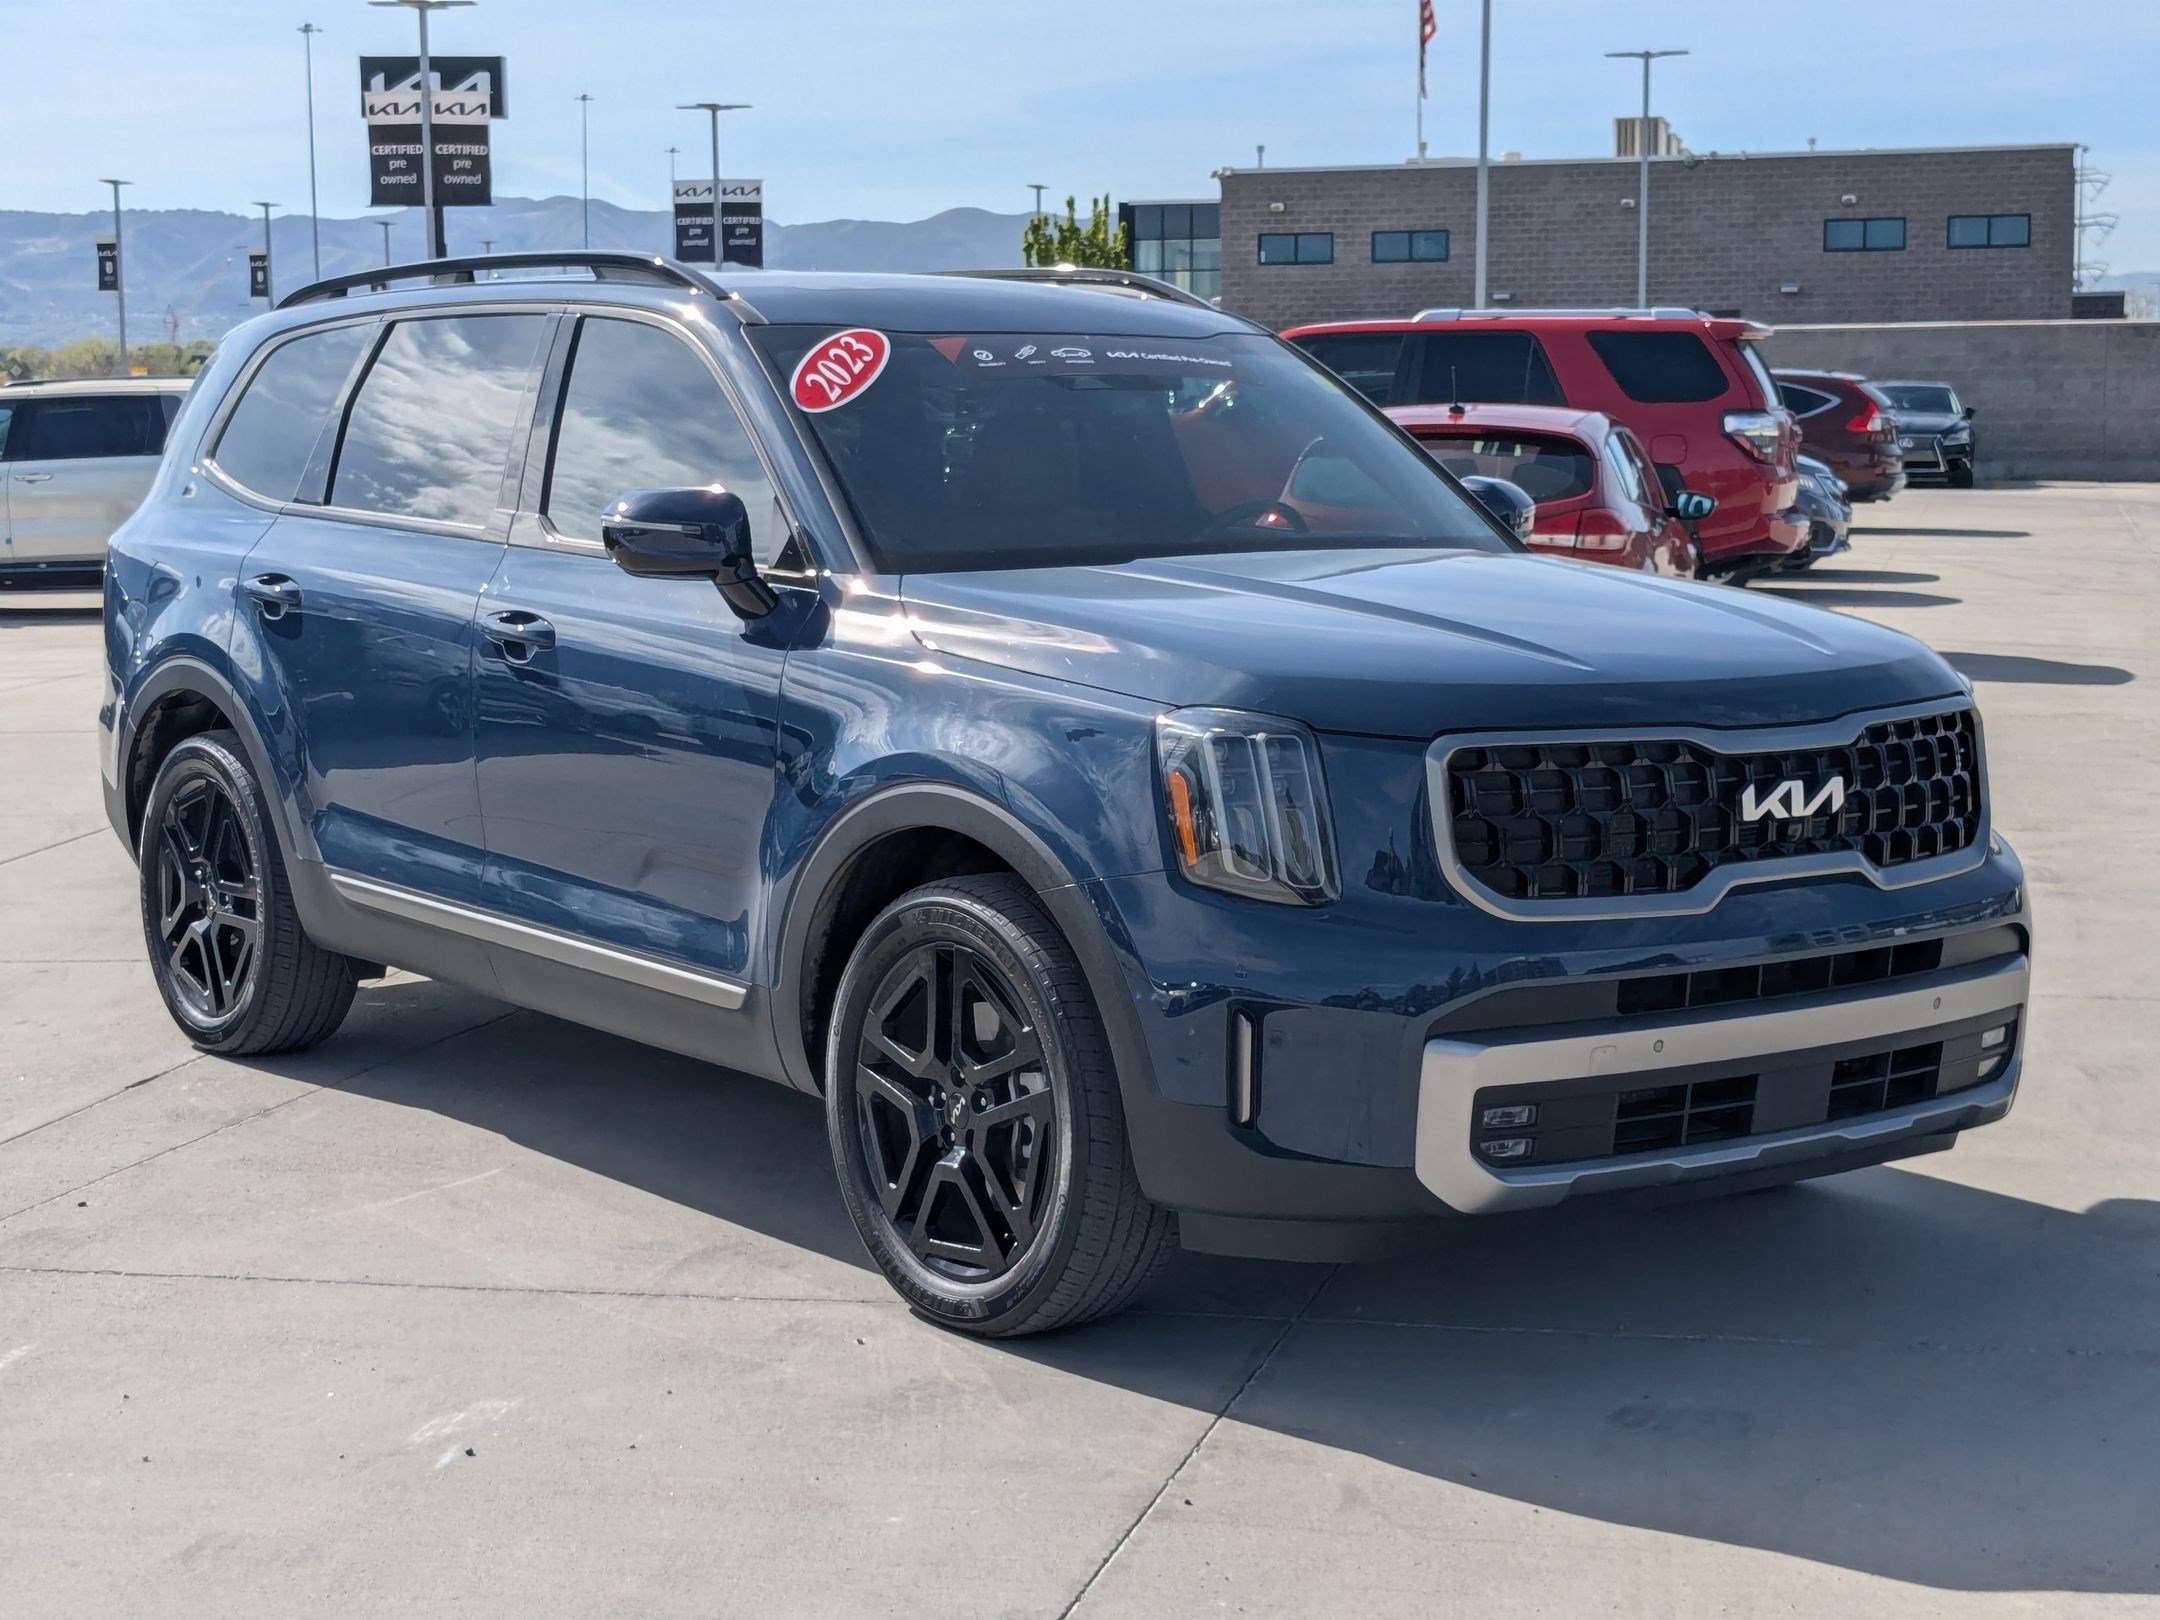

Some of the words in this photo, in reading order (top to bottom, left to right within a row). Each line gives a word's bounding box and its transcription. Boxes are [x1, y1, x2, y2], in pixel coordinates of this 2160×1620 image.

[368, 102, 421, 116] KIA
[434, 102, 487, 116] KIA
[371, 144, 424, 155] CERTIFIED
[435, 144, 488, 156] CERTIFIED
[389, 160, 408, 171] pre
[453, 160, 472, 171] pre
[380, 173, 417, 185] owned
[443, 173, 482, 185] owned
[676, 187, 712, 197] KIA
[722, 187, 760, 196] KIA
[805, 336, 874, 403] 2023
[1741, 775, 1846, 822] KIA
